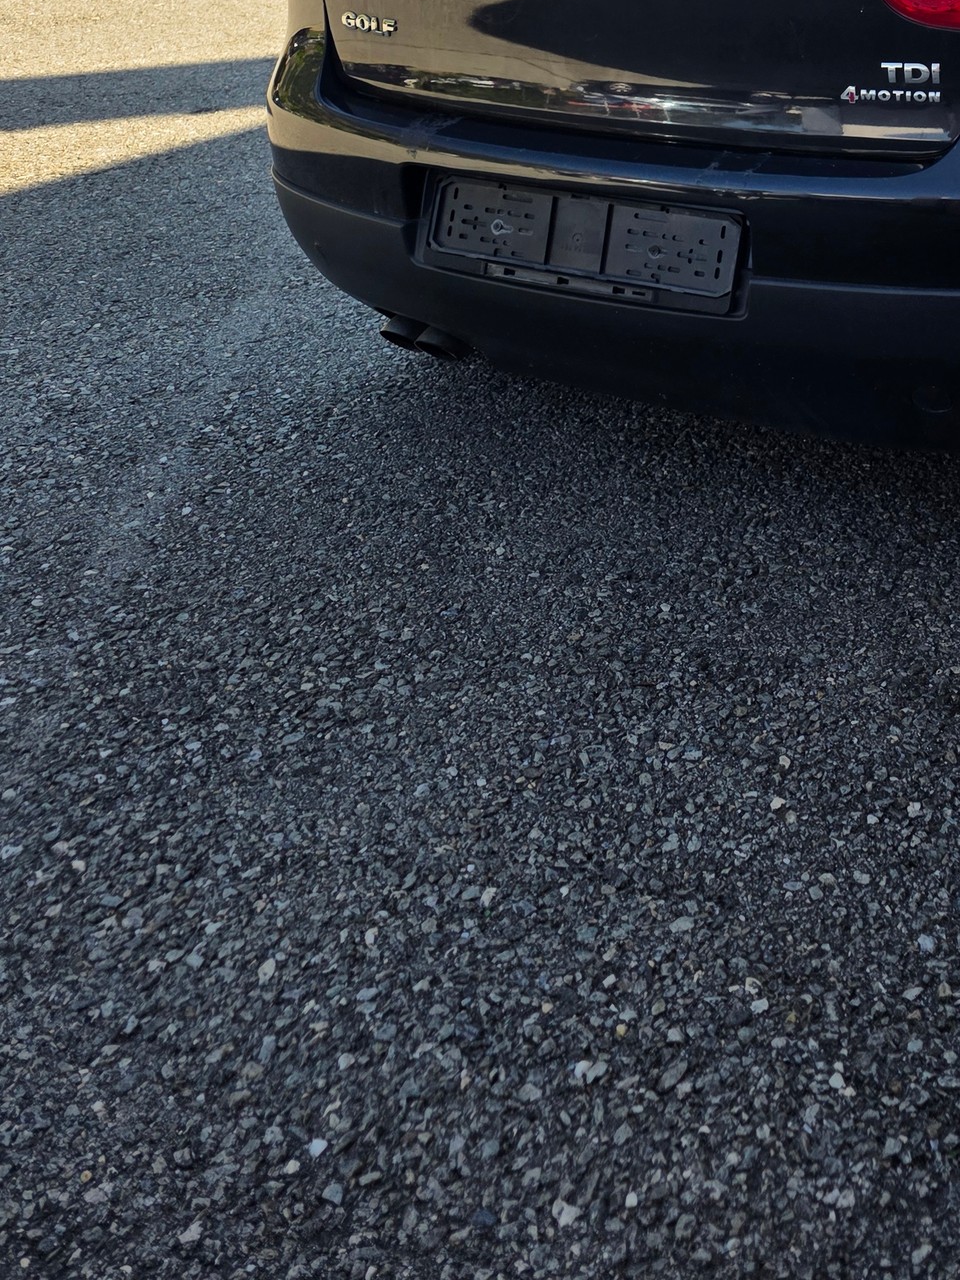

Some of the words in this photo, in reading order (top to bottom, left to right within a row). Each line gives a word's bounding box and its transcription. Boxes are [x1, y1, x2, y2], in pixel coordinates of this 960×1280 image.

[341, 11, 397, 36] GOLF
[880, 62, 940, 84] TDI
[840, 85, 941, 104] 4MOTION
